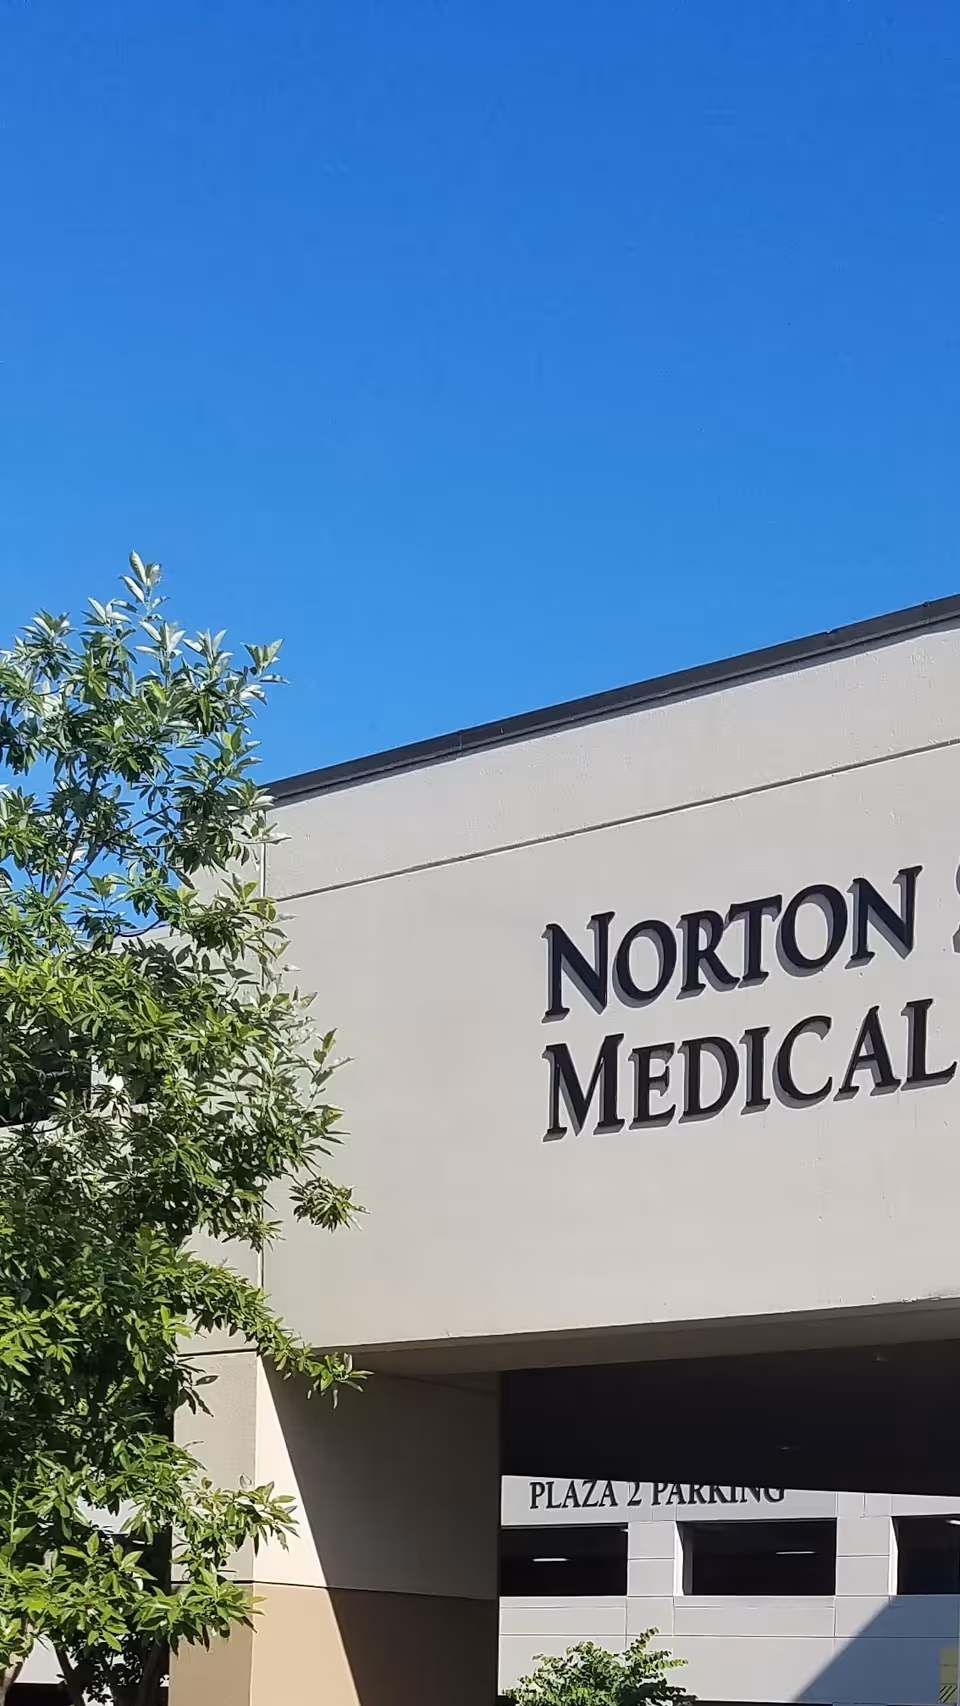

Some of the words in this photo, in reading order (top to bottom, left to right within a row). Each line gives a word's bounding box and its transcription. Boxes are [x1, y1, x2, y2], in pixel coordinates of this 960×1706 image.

[544, 865, 922, 1018] NORTON
[544, 999, 957, 1138] MEDICAL
[529, 1479, 619, 1509] PLAZA
[626, 1481, 643, 1507] 2
